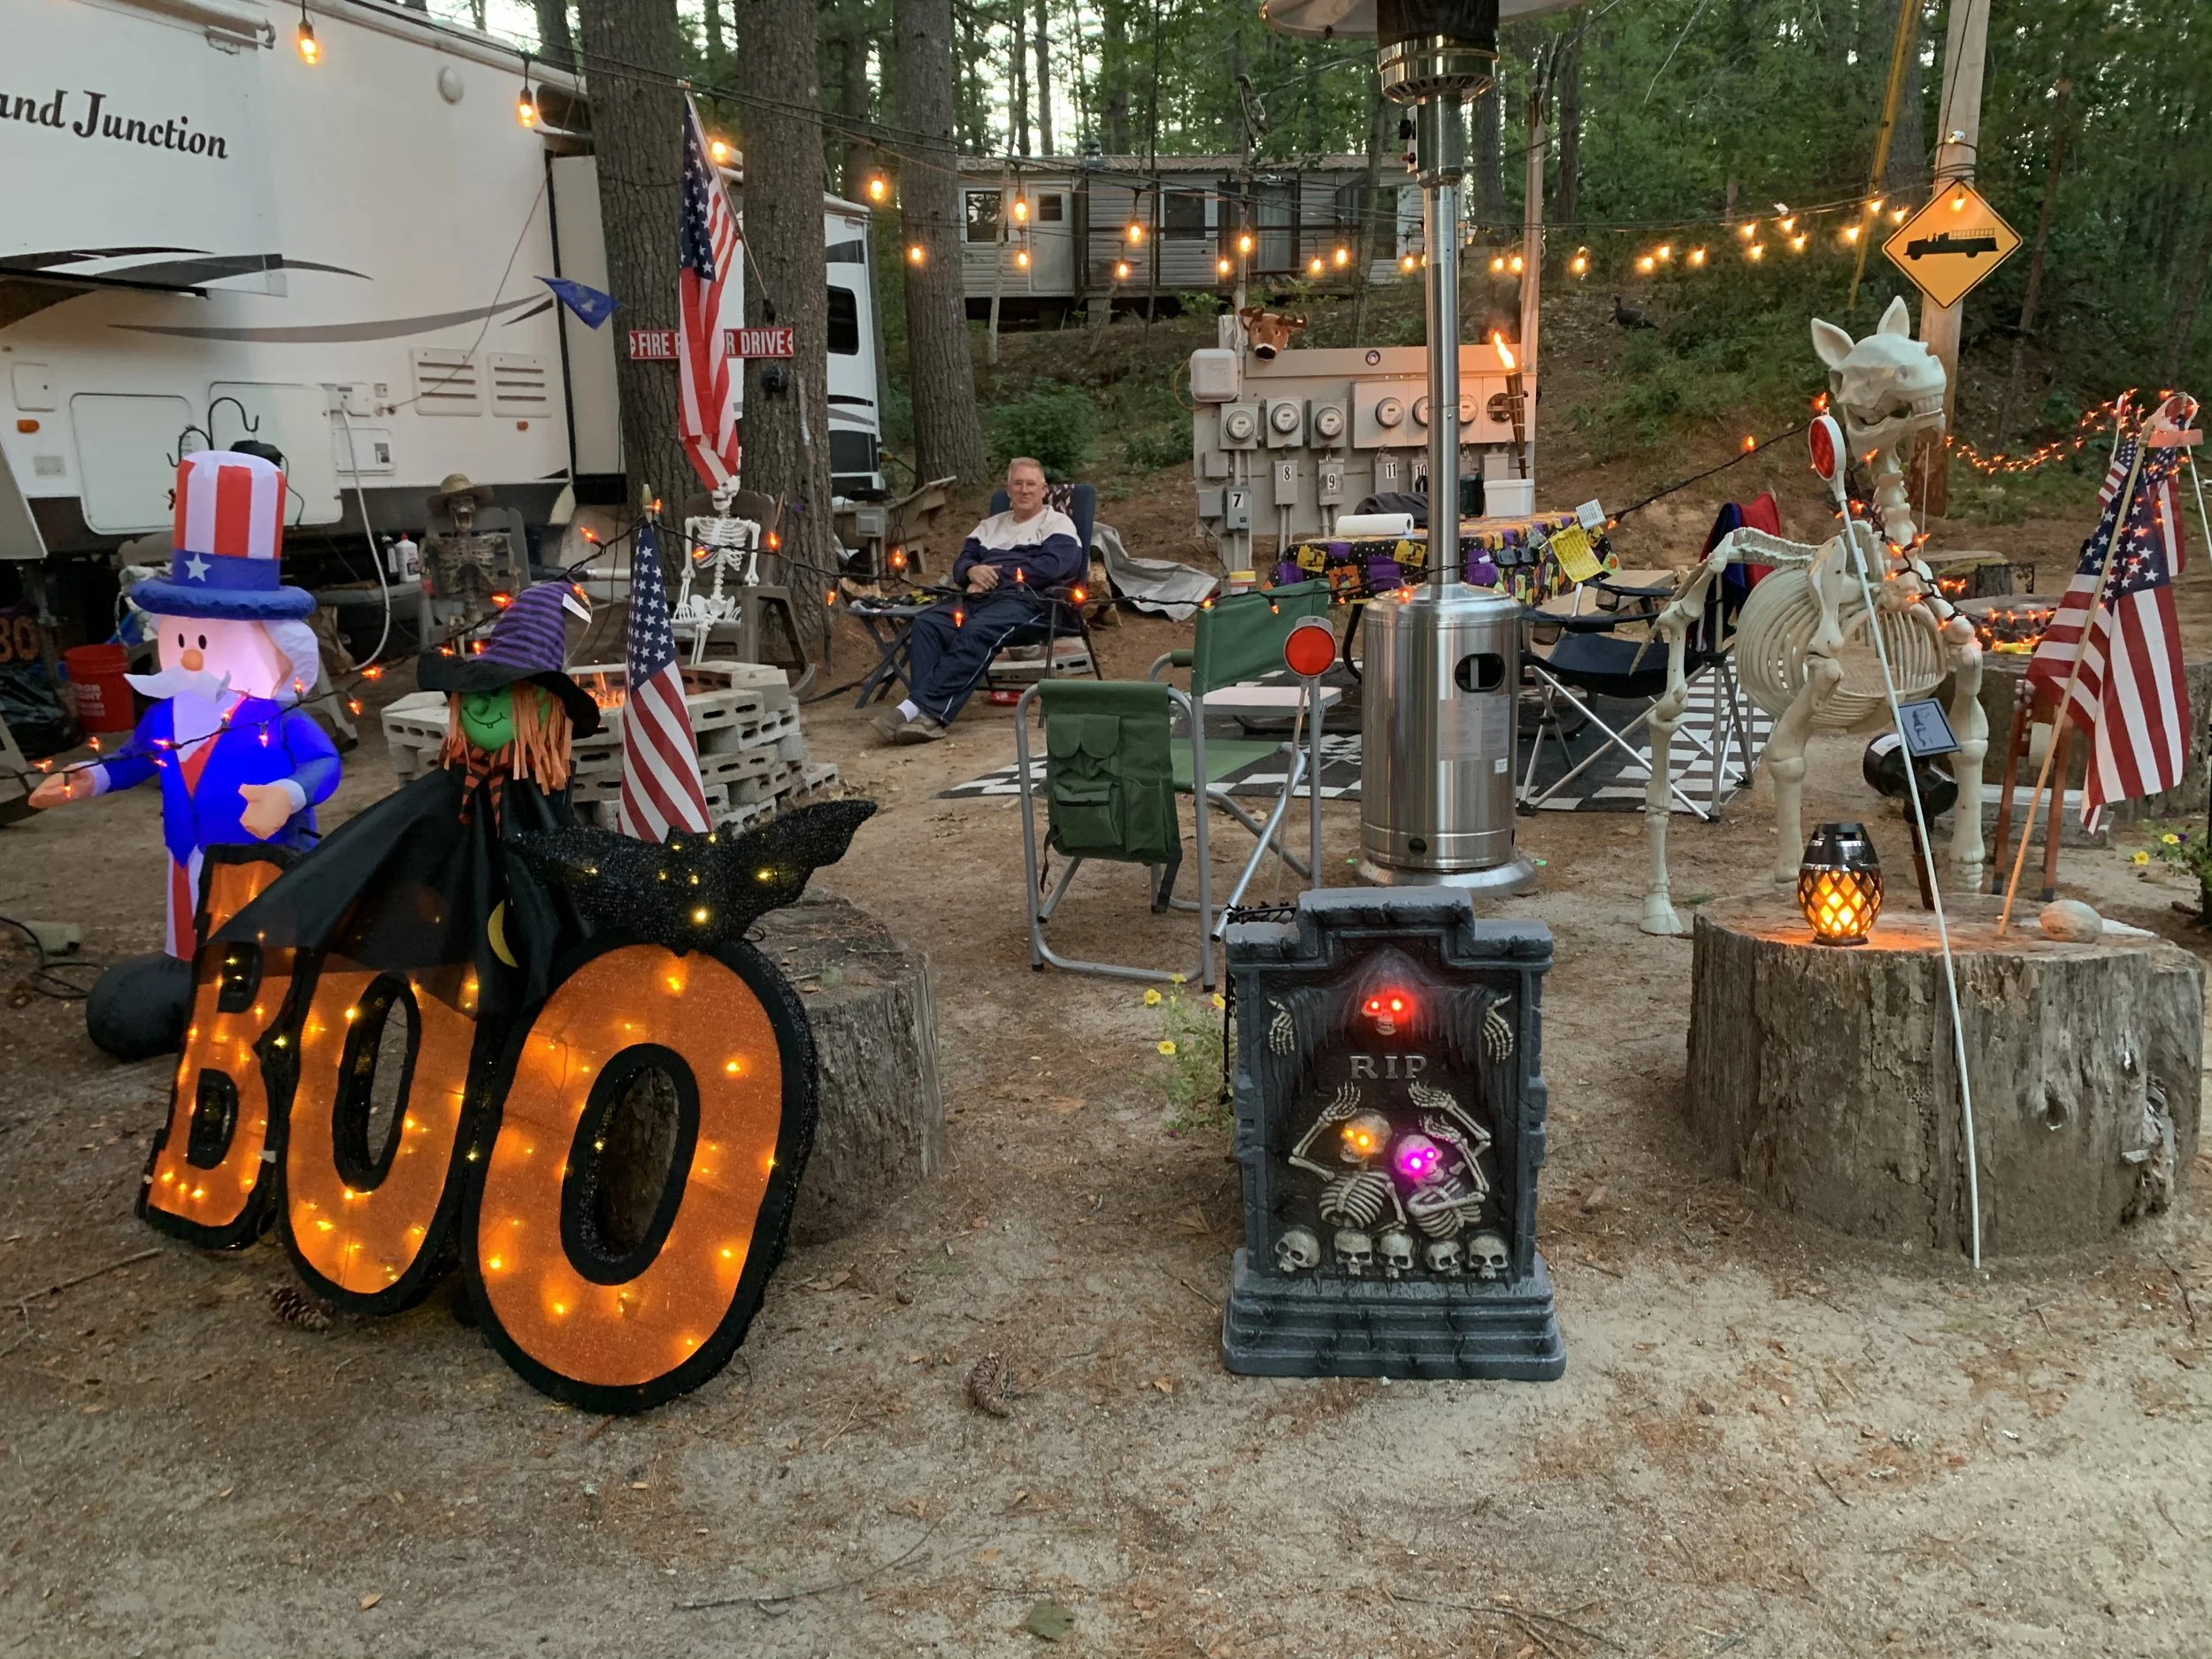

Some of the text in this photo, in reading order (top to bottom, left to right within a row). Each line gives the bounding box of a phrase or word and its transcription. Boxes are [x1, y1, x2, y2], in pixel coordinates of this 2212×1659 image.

[73, 89, 228, 159] Junction
[638, 332, 671, 357] FIRE
[741, 330, 786, 355] DRIVE
[1284, 466, 1290, 480] 8
[1386, 464, 1396, 478] 11
[1329, 474, 1335, 488] 9
[1233, 493, 1241, 508] 7
[1348, 1055, 1428, 1079] RIP
[135, 843, 818, 1416] BOO
